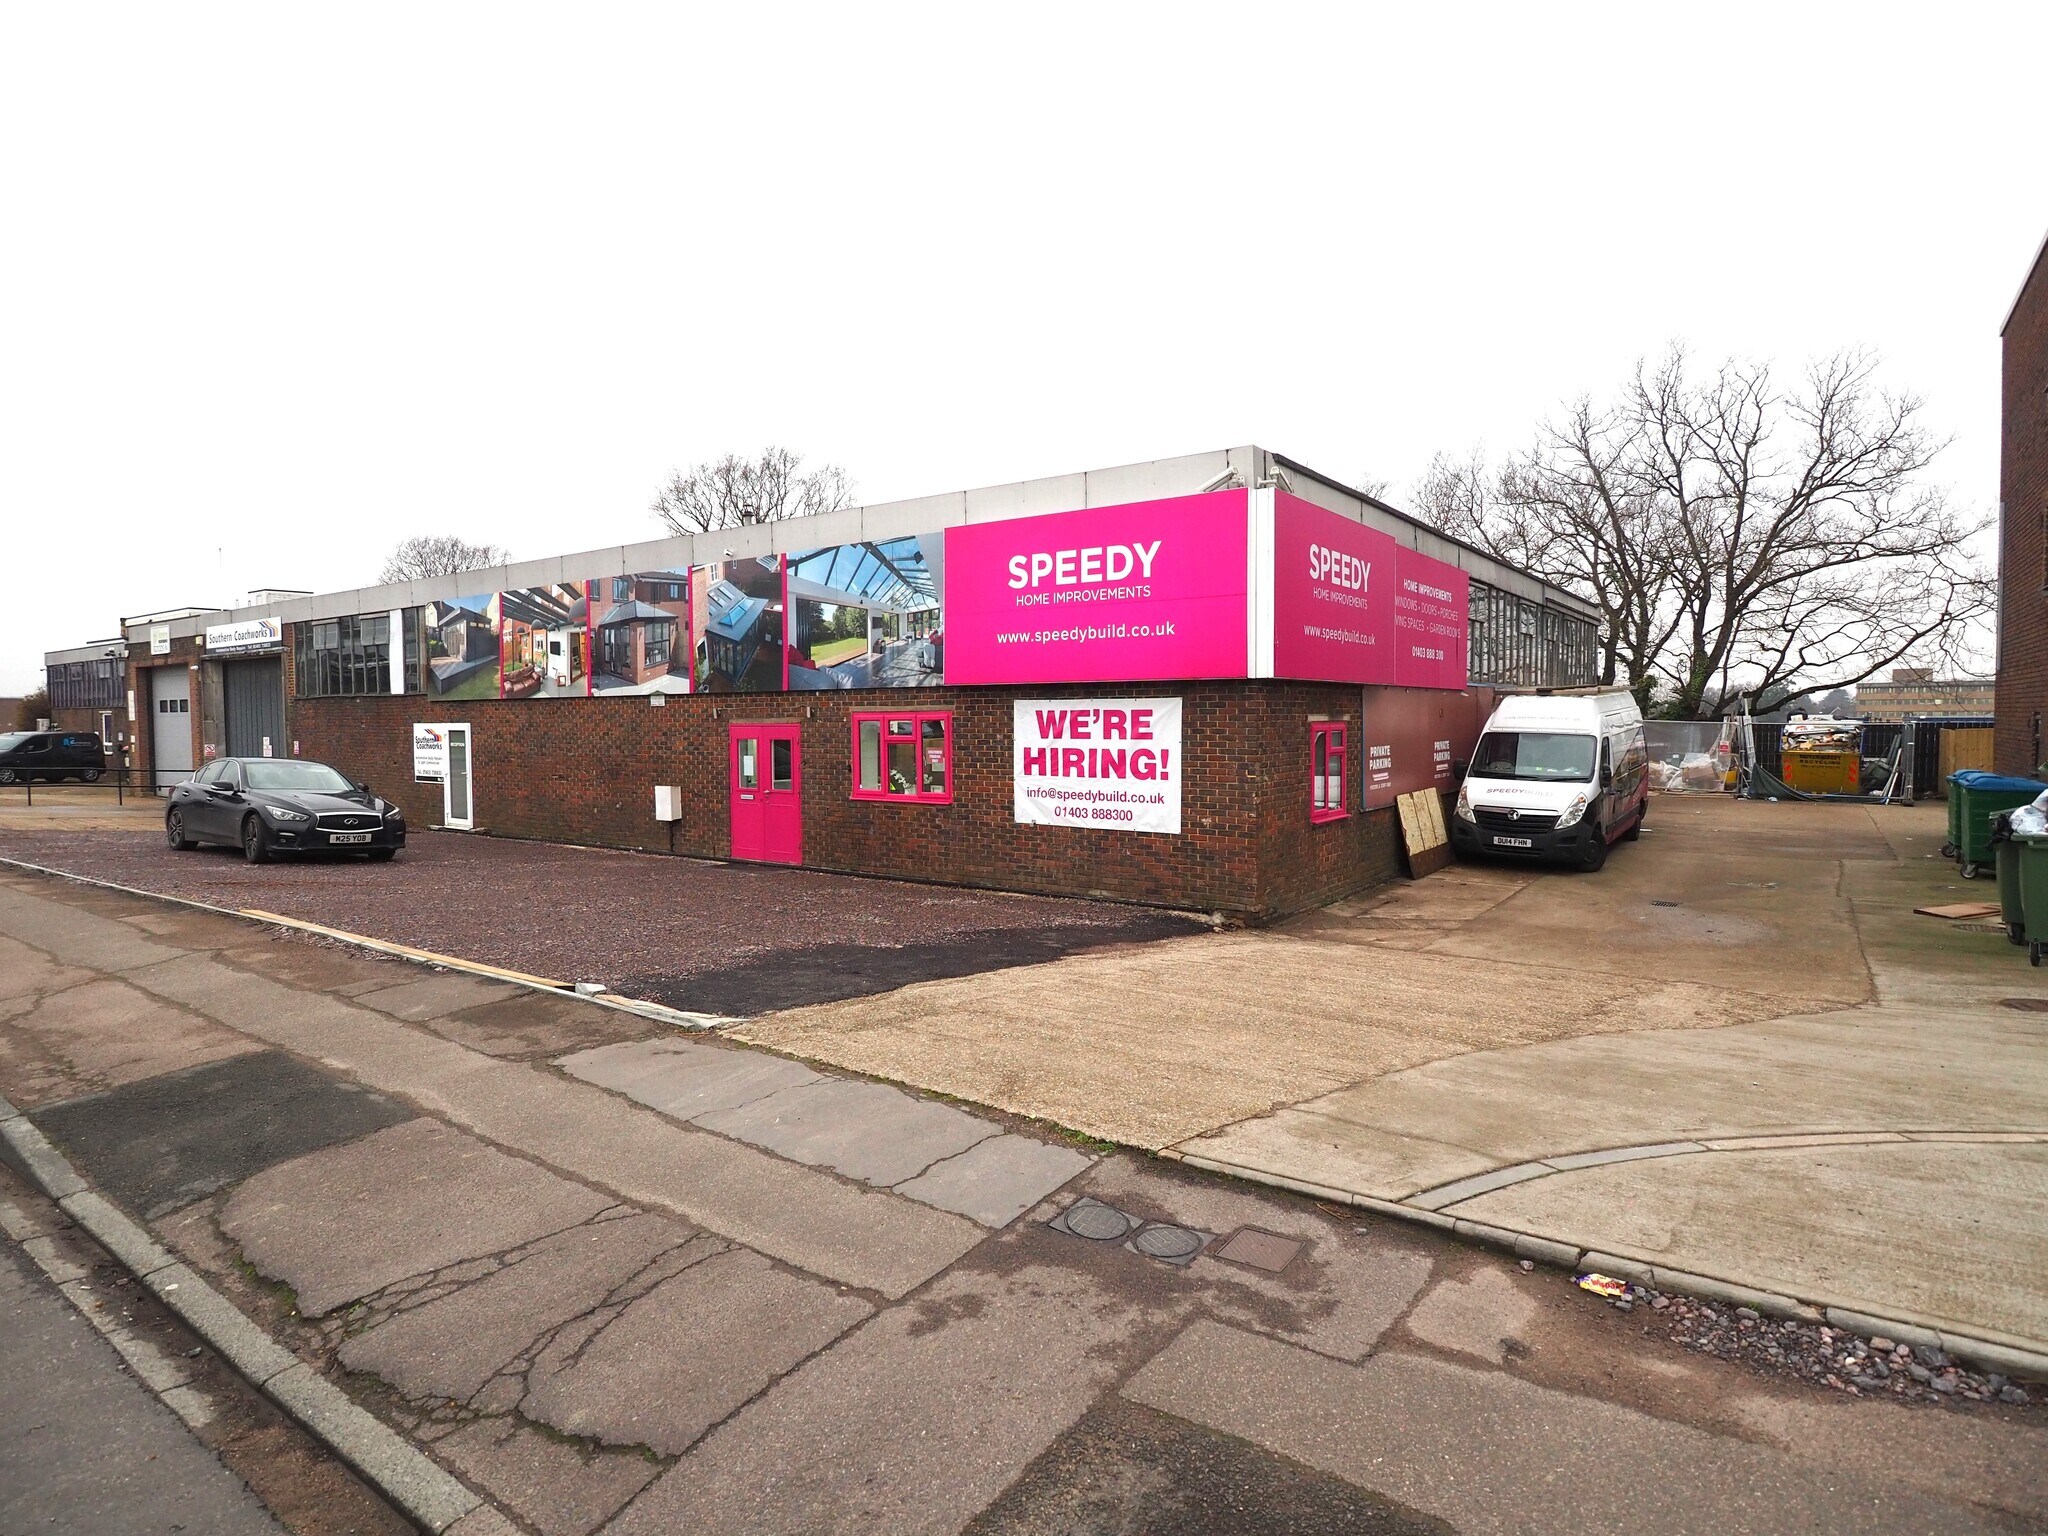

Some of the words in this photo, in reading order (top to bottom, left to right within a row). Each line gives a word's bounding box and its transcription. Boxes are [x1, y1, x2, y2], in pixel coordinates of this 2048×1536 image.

[1008, 540, 1162, 589] SPEEDY
[1309, 543, 1371, 593] SPEEDY
[1016, 593, 1050, 607] HOME
[1053, 585, 1151, 604] IMPROVEMENTS
[1313, 586, 1329, 601] HOME
[1330, 590, 1368, 610] IMPROVEMENTS
[1403, 578, 1418, 593] HOME
[1418, 582, 1452, 603] IMPROVEMENTS
[1421, 602, 1437, 616] DOORS
[1440, 607, 1459, 622] PORCHES
[997, 621, 1175, 644] www.speedybuild.co.uk
[1407, 617, 1425, 632] SPACES
[209, 634, 233, 644] Southern
[234, 627, 268, 641] Coachworks
[1303, 624, 1376, 645] www.speedybuild.co.uk
[1035, 709, 1154, 740] WE'RE
[415, 735, 435, 743] Southern
[1434, 740, 1450, 751] PRIVATE
[1370, 745, 1391, 758] PRIVATE
[1433, 751, 1450, 762] PARKING
[1023, 747, 1169, 781] HIRING!
[1369, 757, 1392, 771] PARKING
[1027, 787, 1165, 805] info@speedybuild.co.uk
[1054, 806, 1089, 819] 01403
[1091, 808, 1133, 822] 888300
[1513, 838, 1528, 846] FHN
